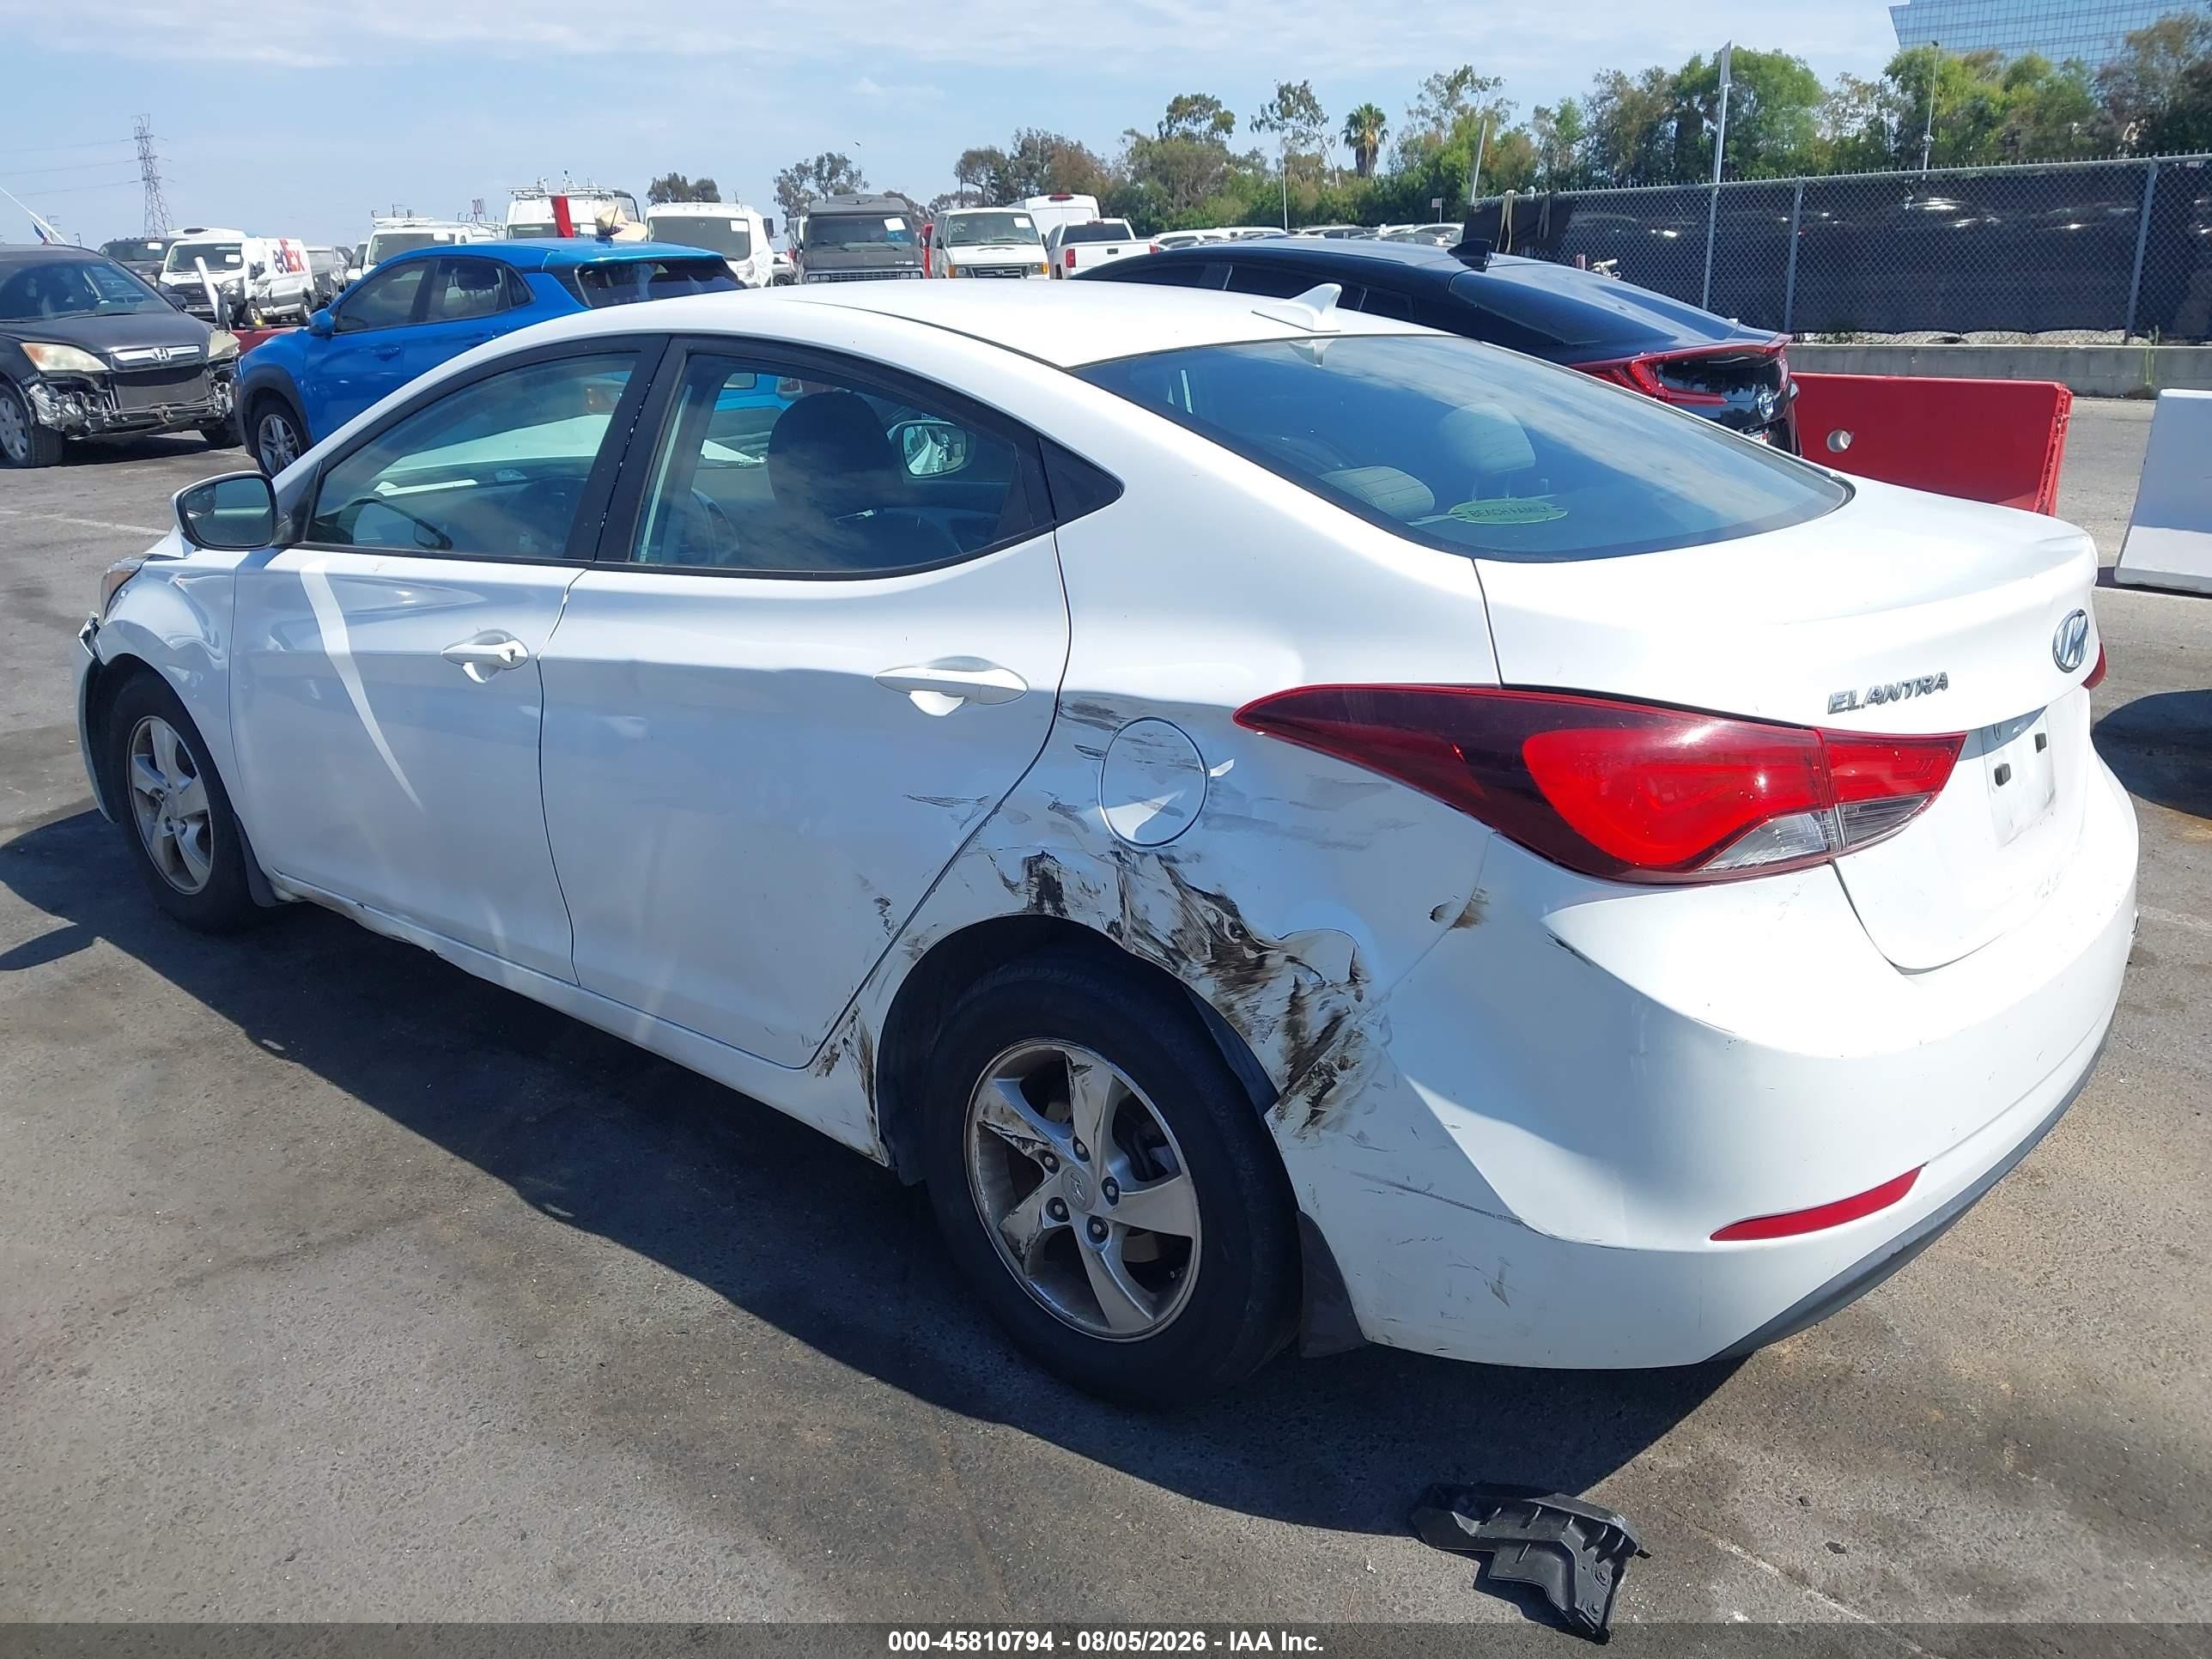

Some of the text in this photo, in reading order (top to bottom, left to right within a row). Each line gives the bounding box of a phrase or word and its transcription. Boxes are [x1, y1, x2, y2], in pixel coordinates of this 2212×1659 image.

[1468, 505, 1547, 518] BEACH FAMILY
[1827, 672, 1949, 714] ELANTRA
